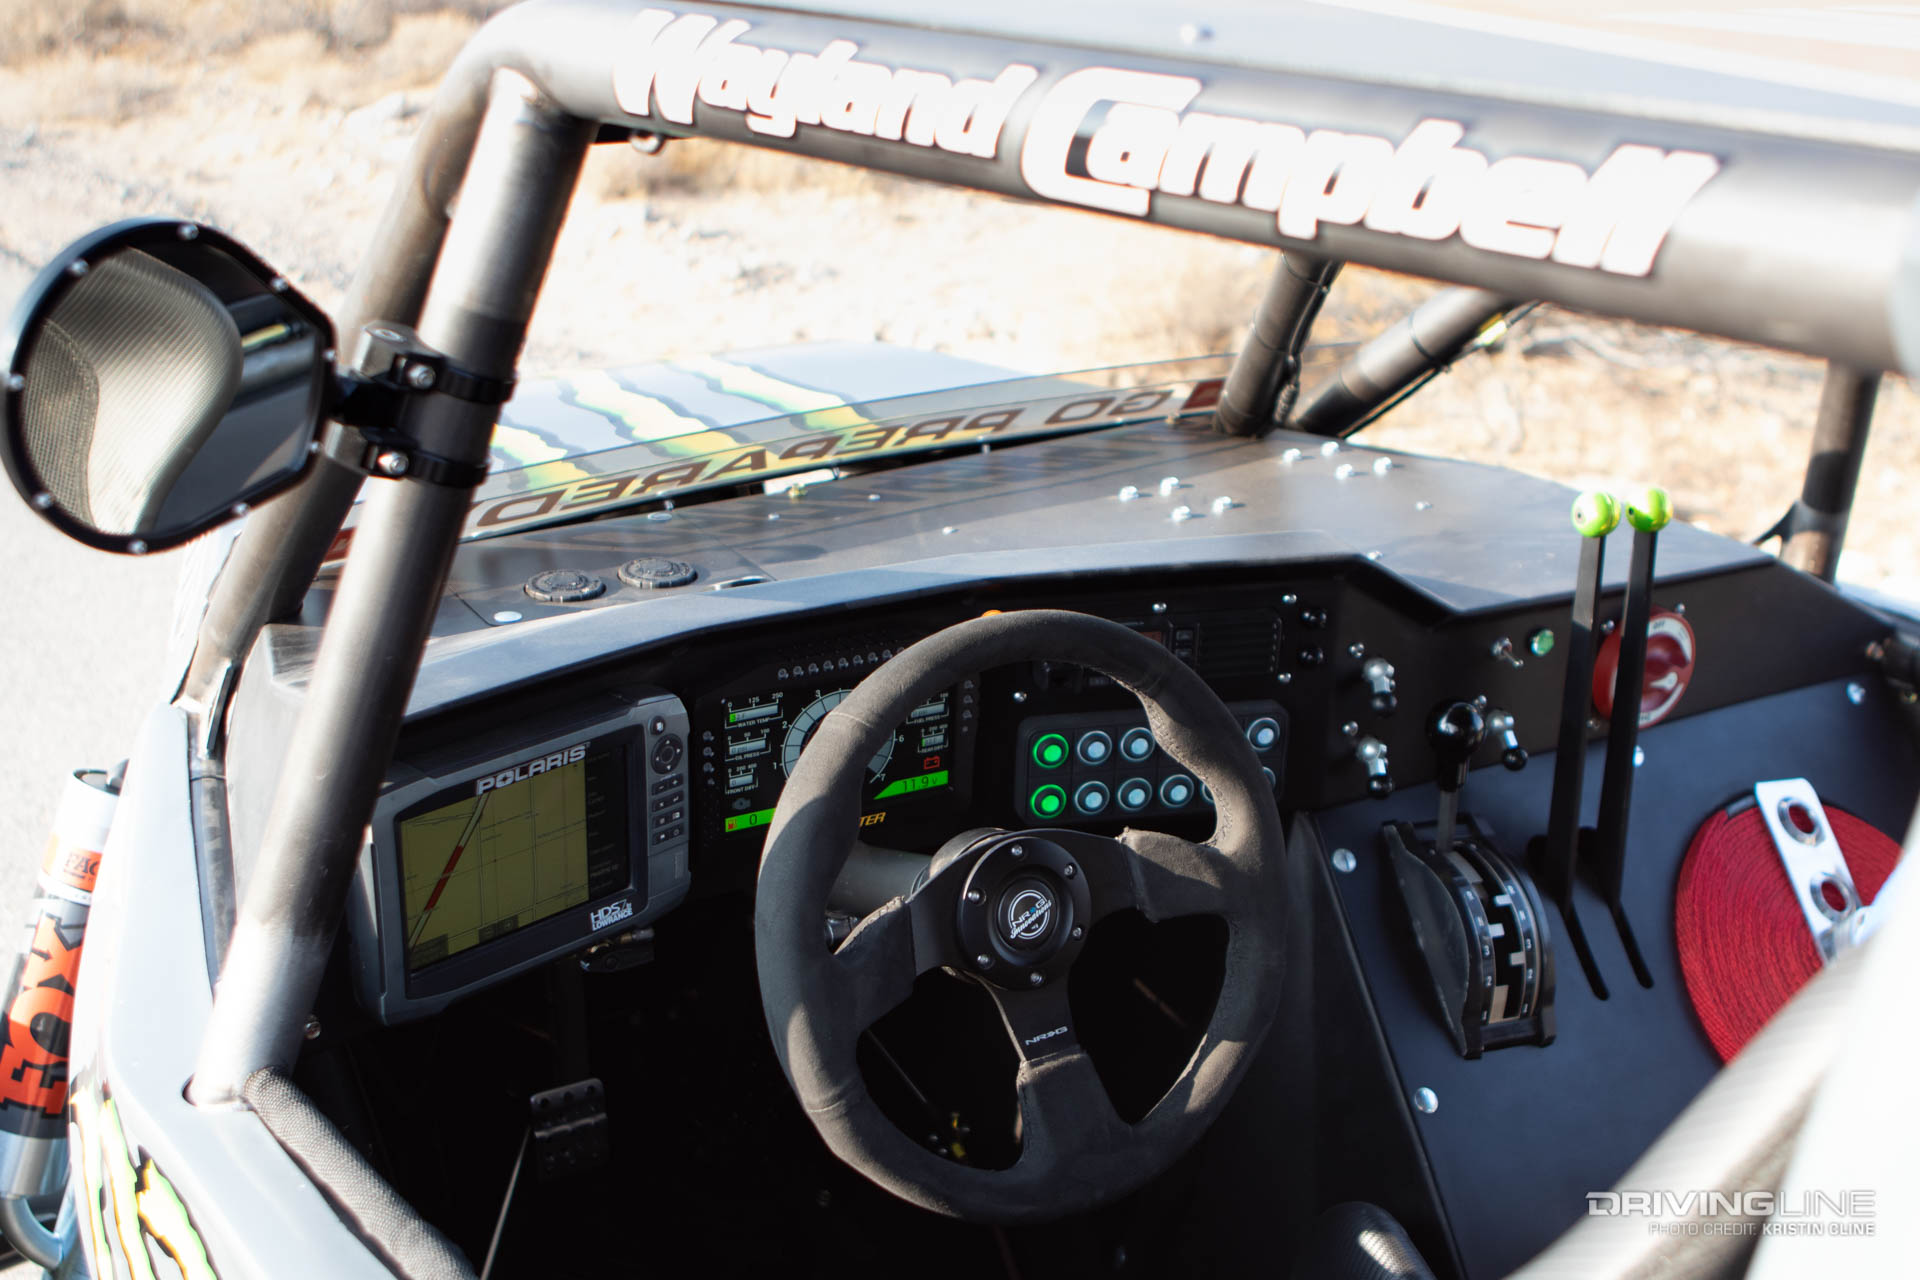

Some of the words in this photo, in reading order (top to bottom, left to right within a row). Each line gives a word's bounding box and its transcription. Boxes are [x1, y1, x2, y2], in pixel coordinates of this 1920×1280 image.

[613, 8, 1038, 158] Wayland
[1020, 66, 1720, 278] Campbell
[782, 721, 788, 729] 2
[476, 745, 586, 796] POLARIS
[592, 909, 633, 931] LOWRANCE
